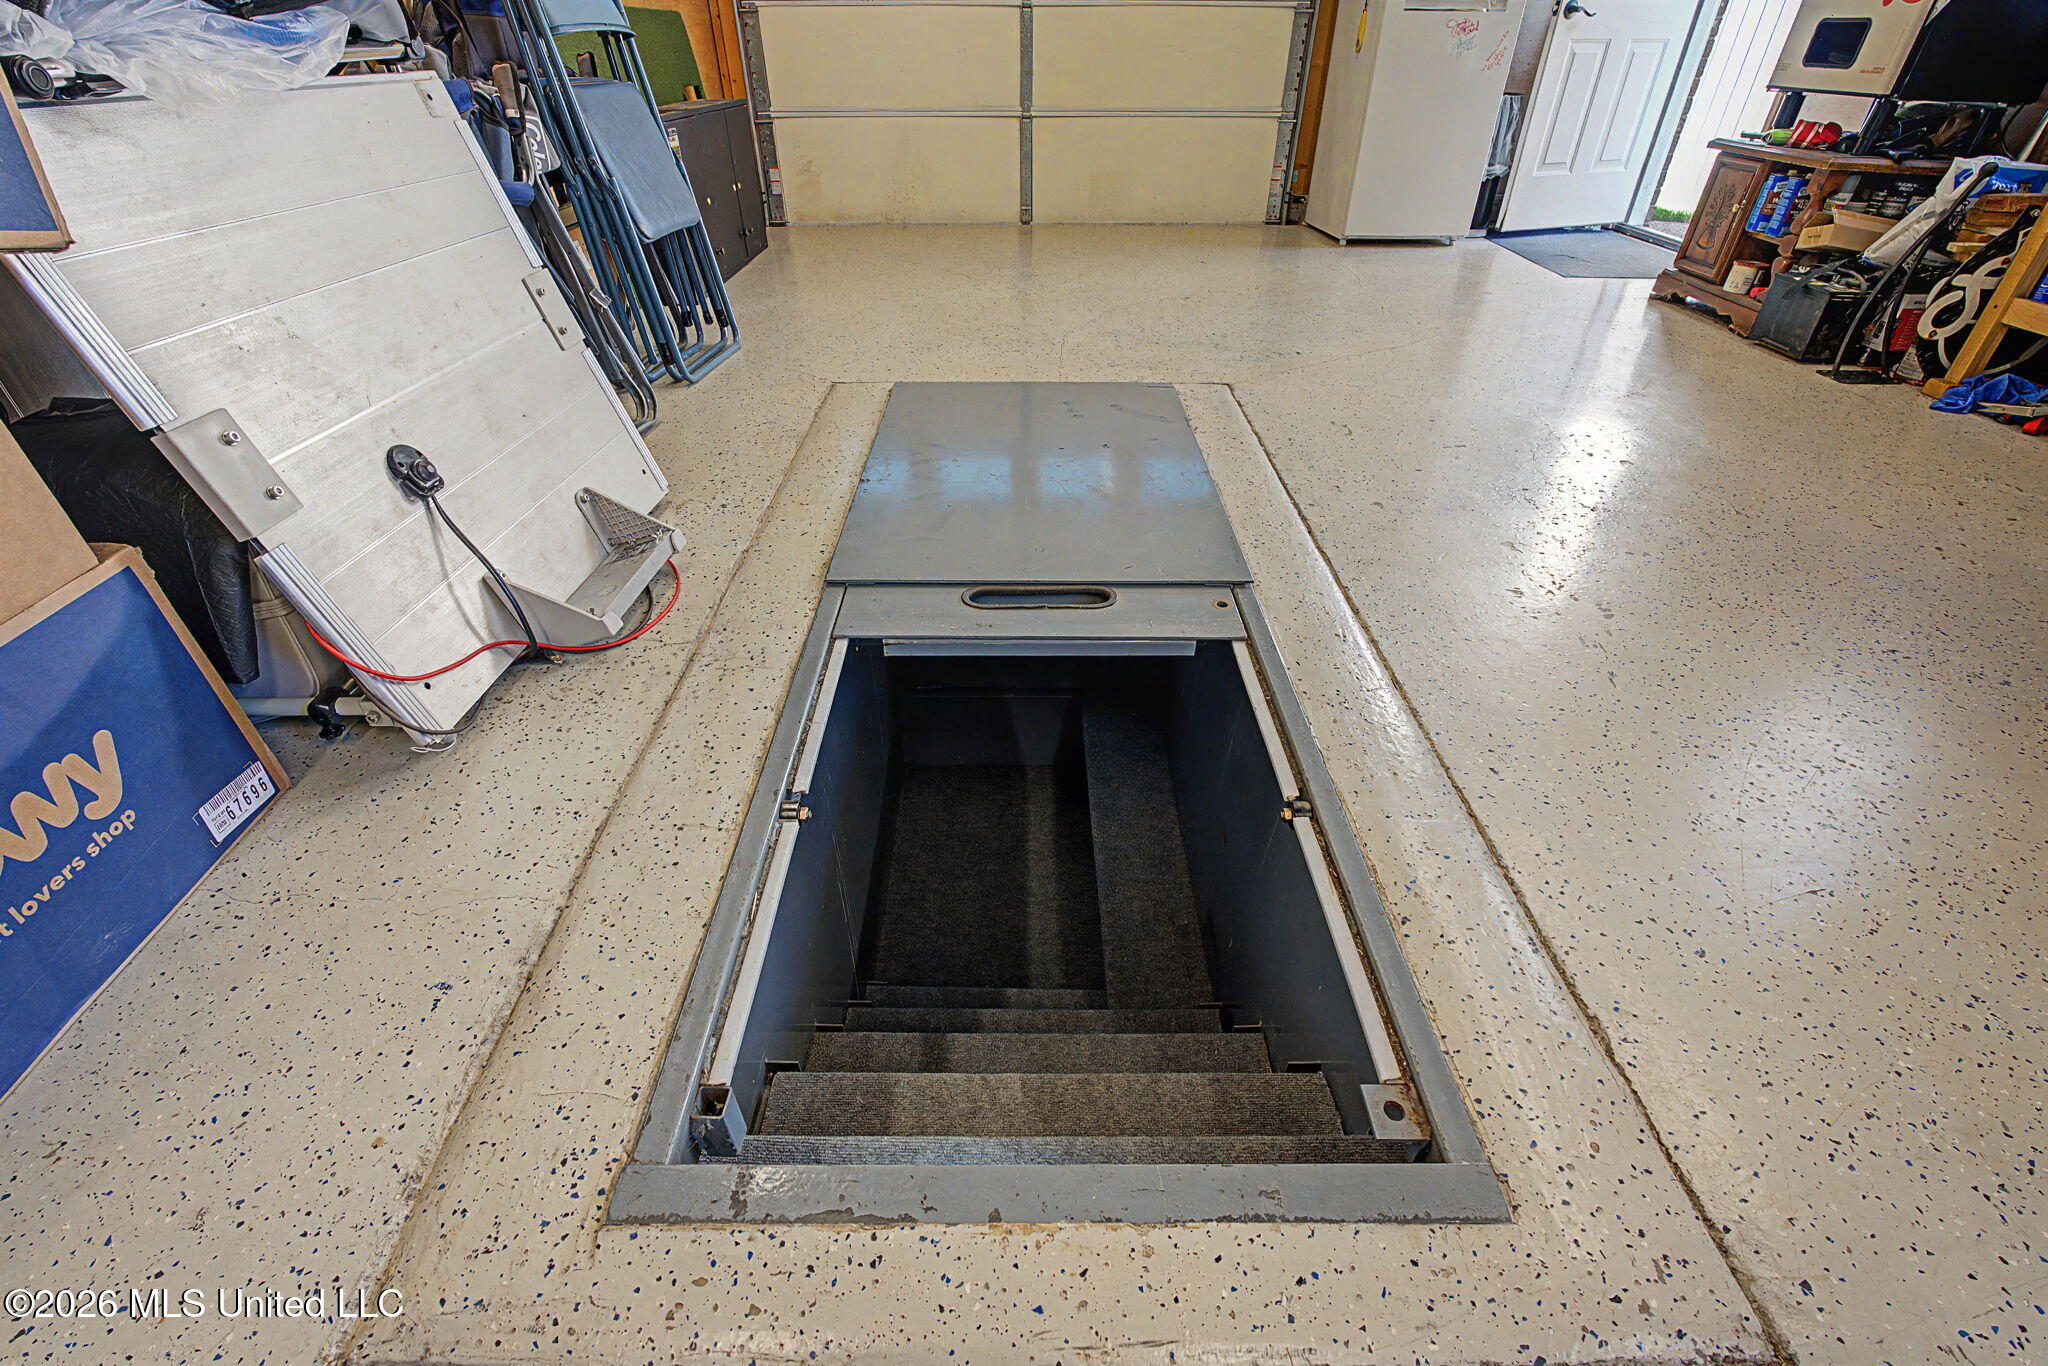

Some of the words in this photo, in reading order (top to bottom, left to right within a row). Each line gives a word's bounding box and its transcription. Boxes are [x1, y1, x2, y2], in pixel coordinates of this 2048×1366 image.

[225, 777, 268, 820] 67696
[8, 855, 86, 925] lovers
[86, 809, 136, 858] shop
